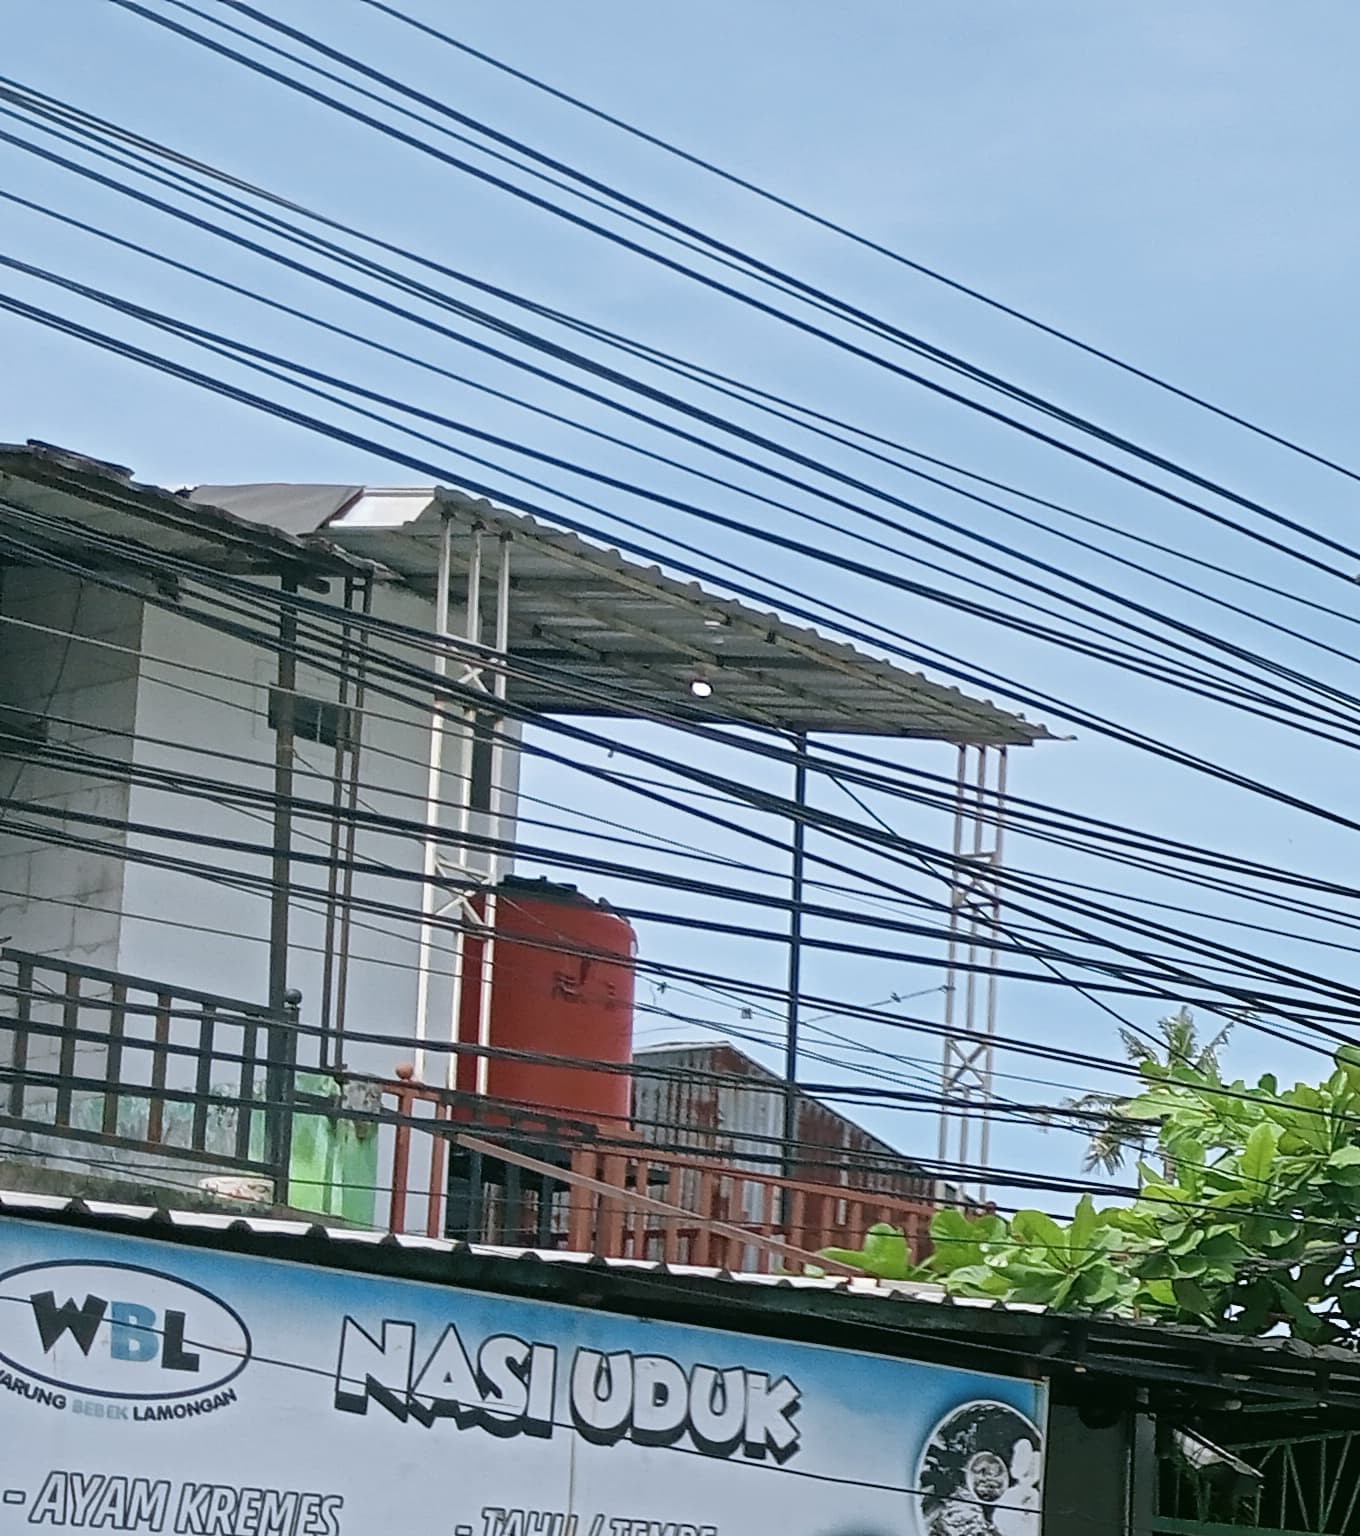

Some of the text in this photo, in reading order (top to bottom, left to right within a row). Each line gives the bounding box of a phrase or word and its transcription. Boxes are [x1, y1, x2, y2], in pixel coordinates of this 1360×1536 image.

[30, 1291, 199, 1372] WBL
[0, 1370, 237, 1421] ARUNG BEBEK LAMONGAN
[335, 1315, 801, 1464] NASI UDUK
[29, 1471, 171, 1531] AYAM
